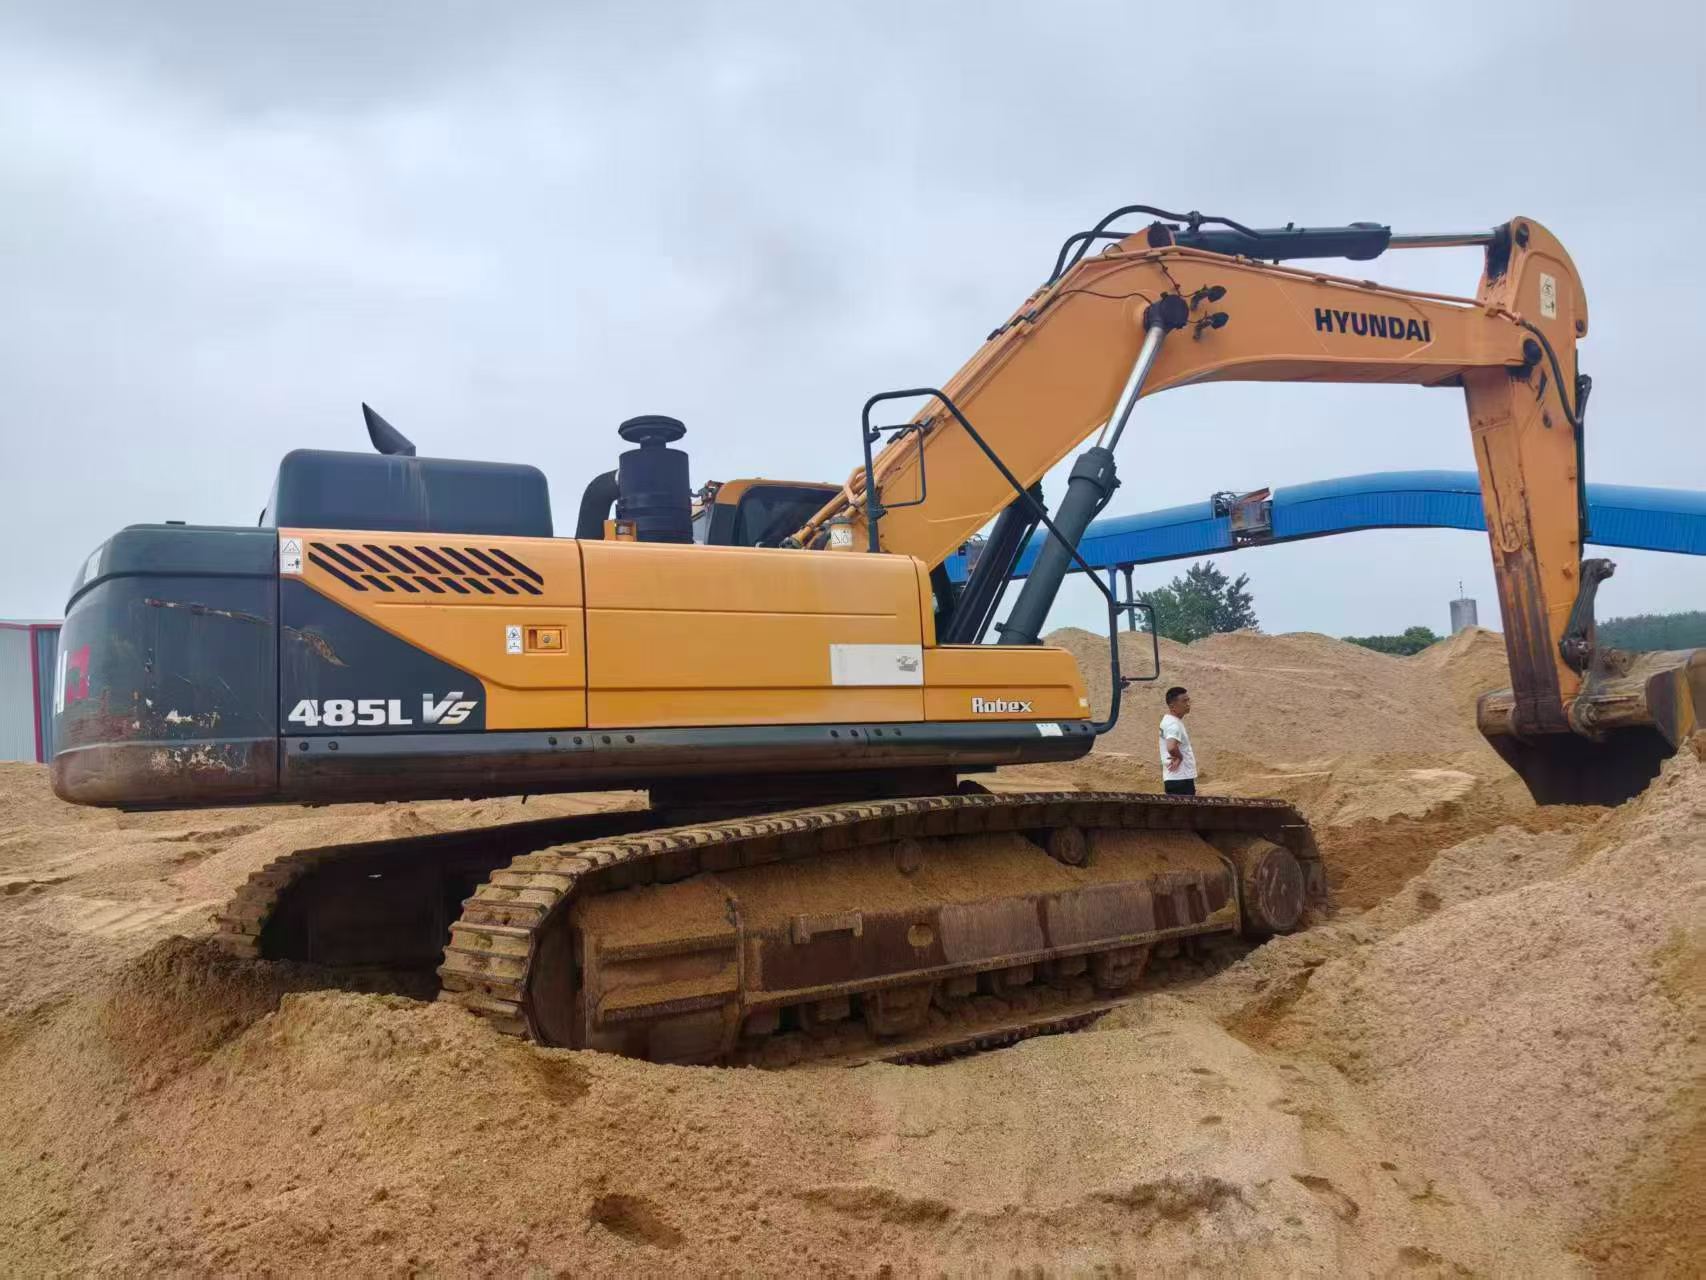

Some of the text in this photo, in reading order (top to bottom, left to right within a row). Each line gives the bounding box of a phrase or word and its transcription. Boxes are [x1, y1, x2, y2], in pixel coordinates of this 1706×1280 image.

[1314, 307, 1431, 342] HYUNDAI
[288, 699, 413, 727] 485L
[971, 697, 1033, 713] Robex
